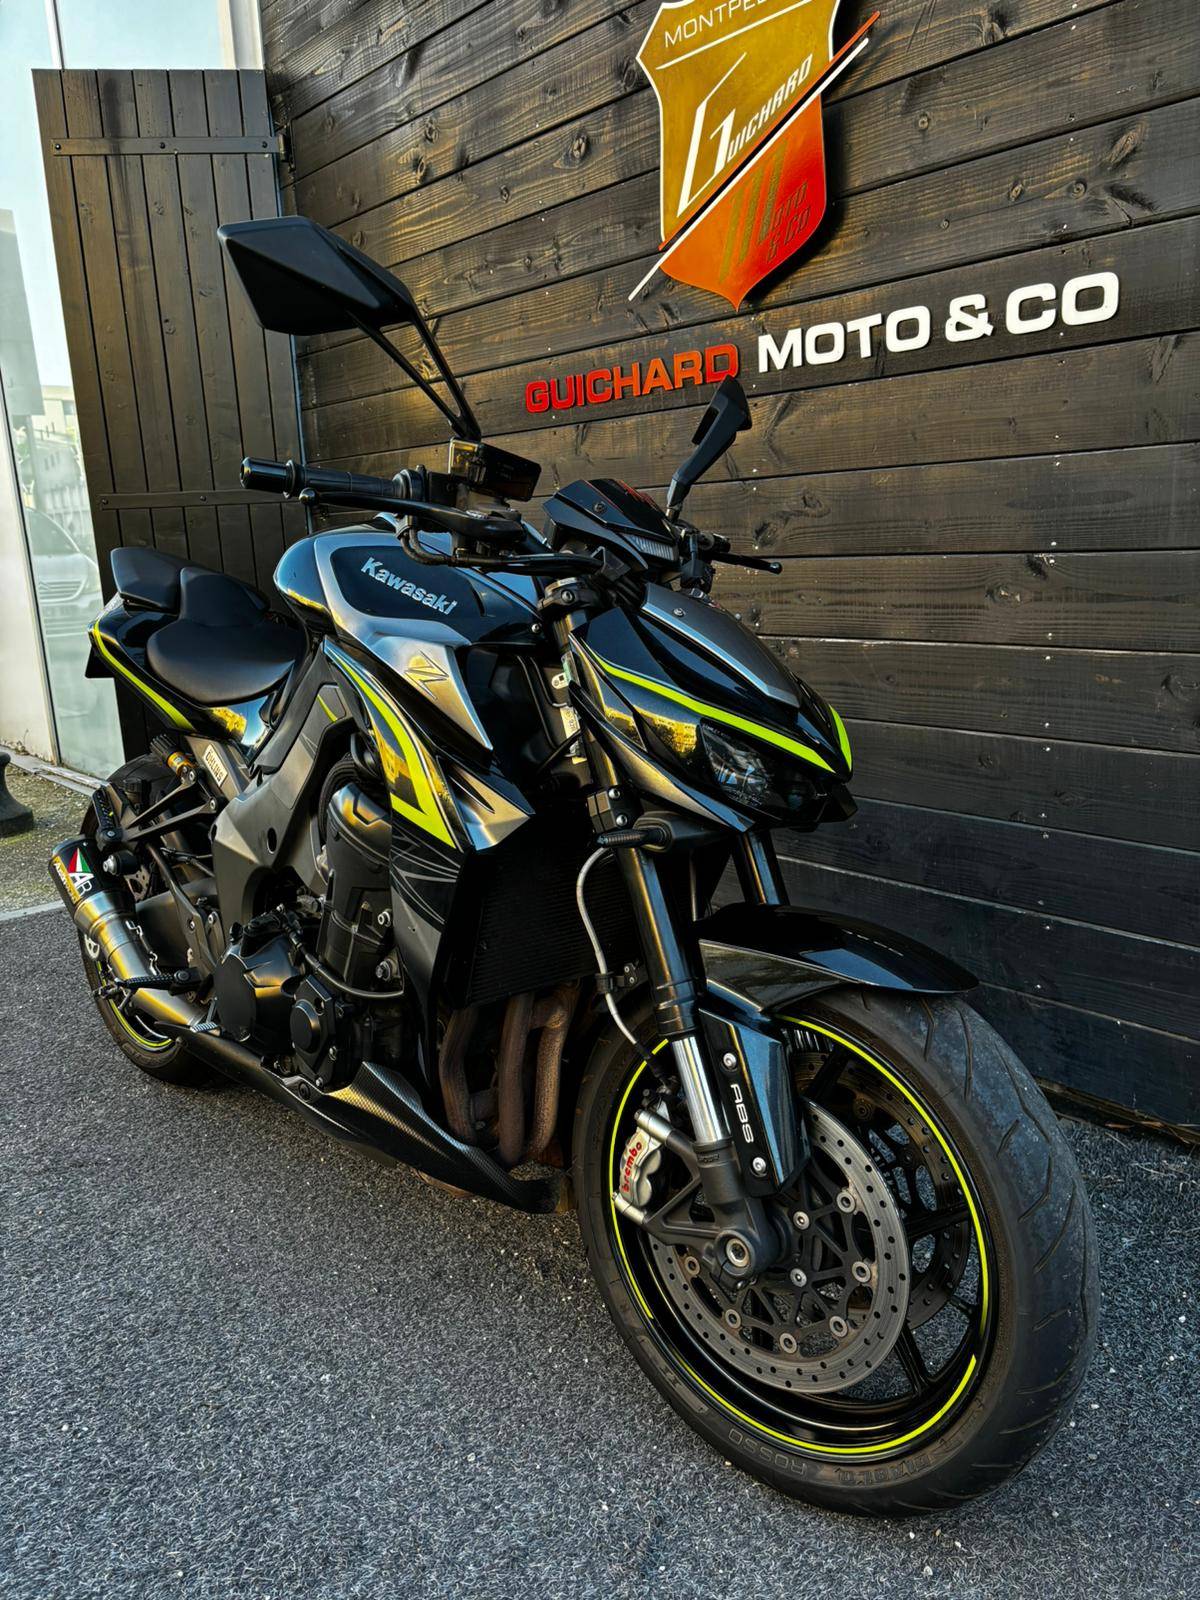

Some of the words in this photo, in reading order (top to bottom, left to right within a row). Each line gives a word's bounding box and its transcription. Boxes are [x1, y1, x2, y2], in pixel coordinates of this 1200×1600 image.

[664, 0, 768, 48] MONTPE
[525, 343, 739, 413] GUICHARD
[758, 305, 931, 373] MOTO
[945, 293, 994, 344] &
[1005, 271, 1120, 335] CO
[361, 557, 458, 615] Kawasaki
[730, 1083, 755, 1144] ABS
[621, 1141, 642, 1193] brembo
[728, 1428, 807, 1475] ROSSO
